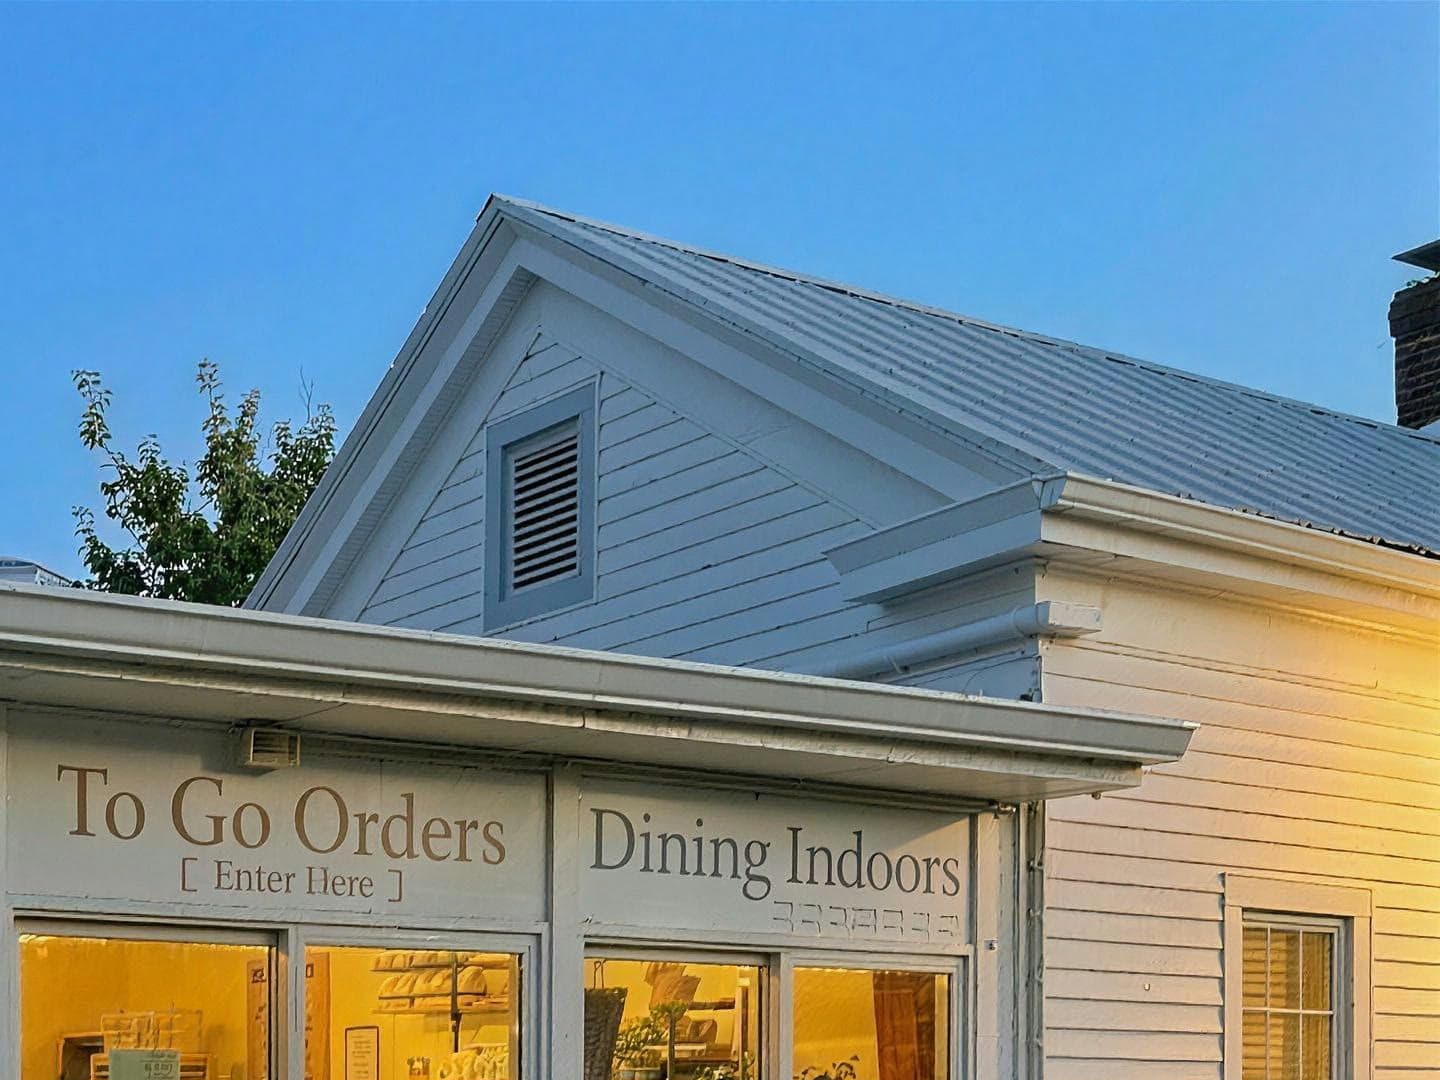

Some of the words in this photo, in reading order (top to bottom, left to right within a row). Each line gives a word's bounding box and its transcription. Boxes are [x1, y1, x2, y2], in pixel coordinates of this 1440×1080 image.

[57, 764, 146, 840] To
[171, 776, 271, 849] Go
[294, 785, 506, 865] Orders
[589, 807, 771, 901] Dining
[786, 826, 961, 897] Indoors
[213, 859, 296, 894] Enter
[305, 867, 374, 898] Here
